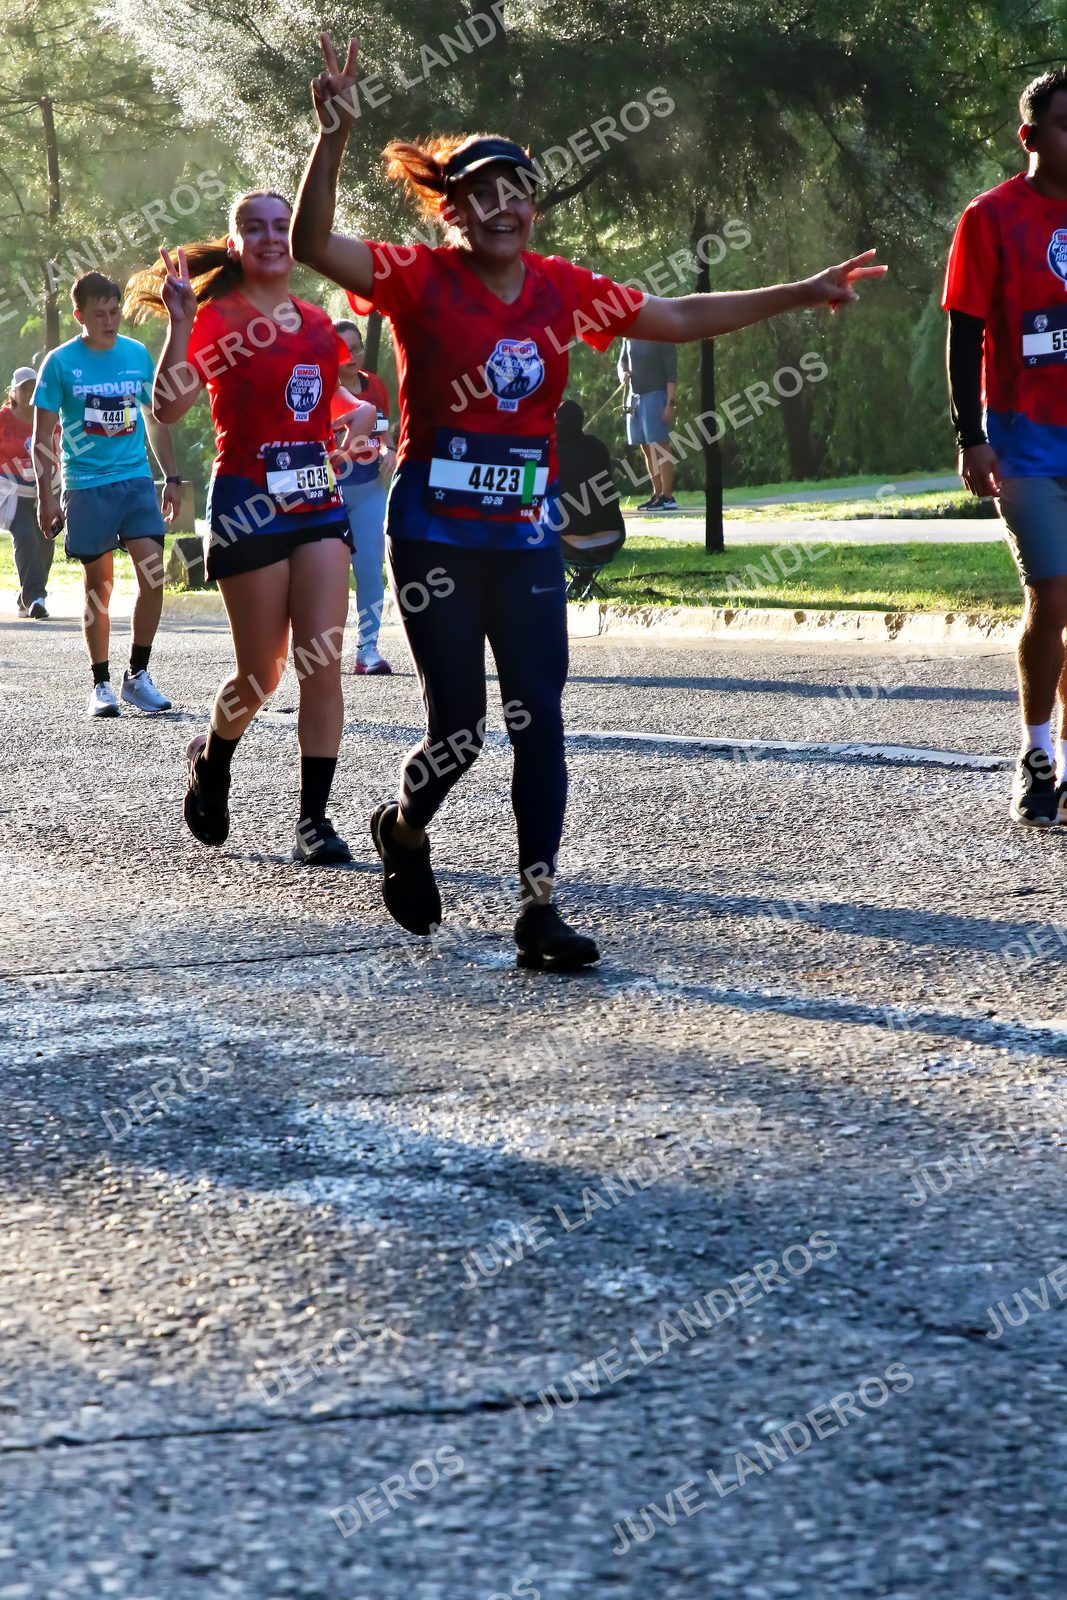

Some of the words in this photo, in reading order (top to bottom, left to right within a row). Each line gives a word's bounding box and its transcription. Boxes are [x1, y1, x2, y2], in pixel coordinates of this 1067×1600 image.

[102, 411, 124, 423] 4441
[295, 467, 329, 490] 5035
[468, 465, 521, 493] 4423
[482, 495, 504, 505] 20-26
